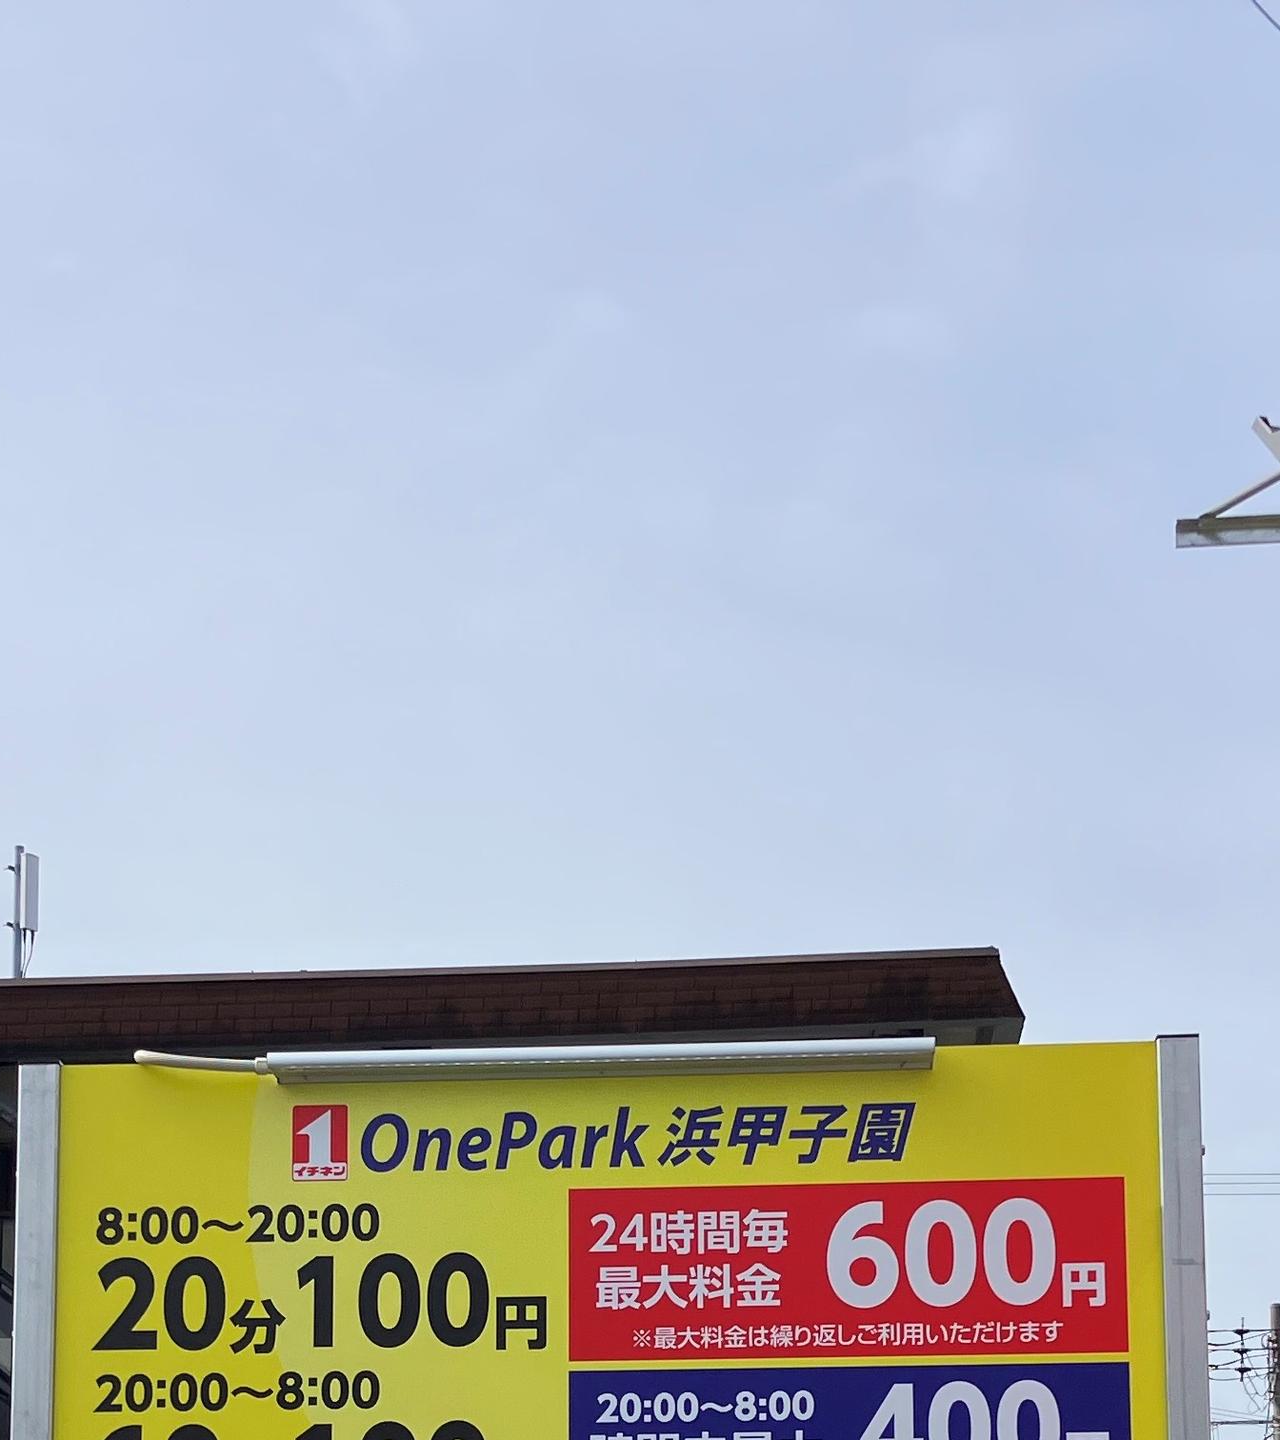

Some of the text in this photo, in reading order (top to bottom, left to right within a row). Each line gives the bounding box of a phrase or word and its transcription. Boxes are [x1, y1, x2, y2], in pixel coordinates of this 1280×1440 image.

[360, 1102, 916, 1172] OnePark 浜甲子園
[295, 1166, 345, 1176] イチネン
[589, 1209, 789, 1255] 24時間毎
[826, 1197, 1106, 1309] 600円
[90, 1252, 548, 1355] 20分100円
[595, 1264, 782, 1310] 最大料金
[632, 1321, 1064, 1350] ※最大料金は繰り返しご利用いただけます
